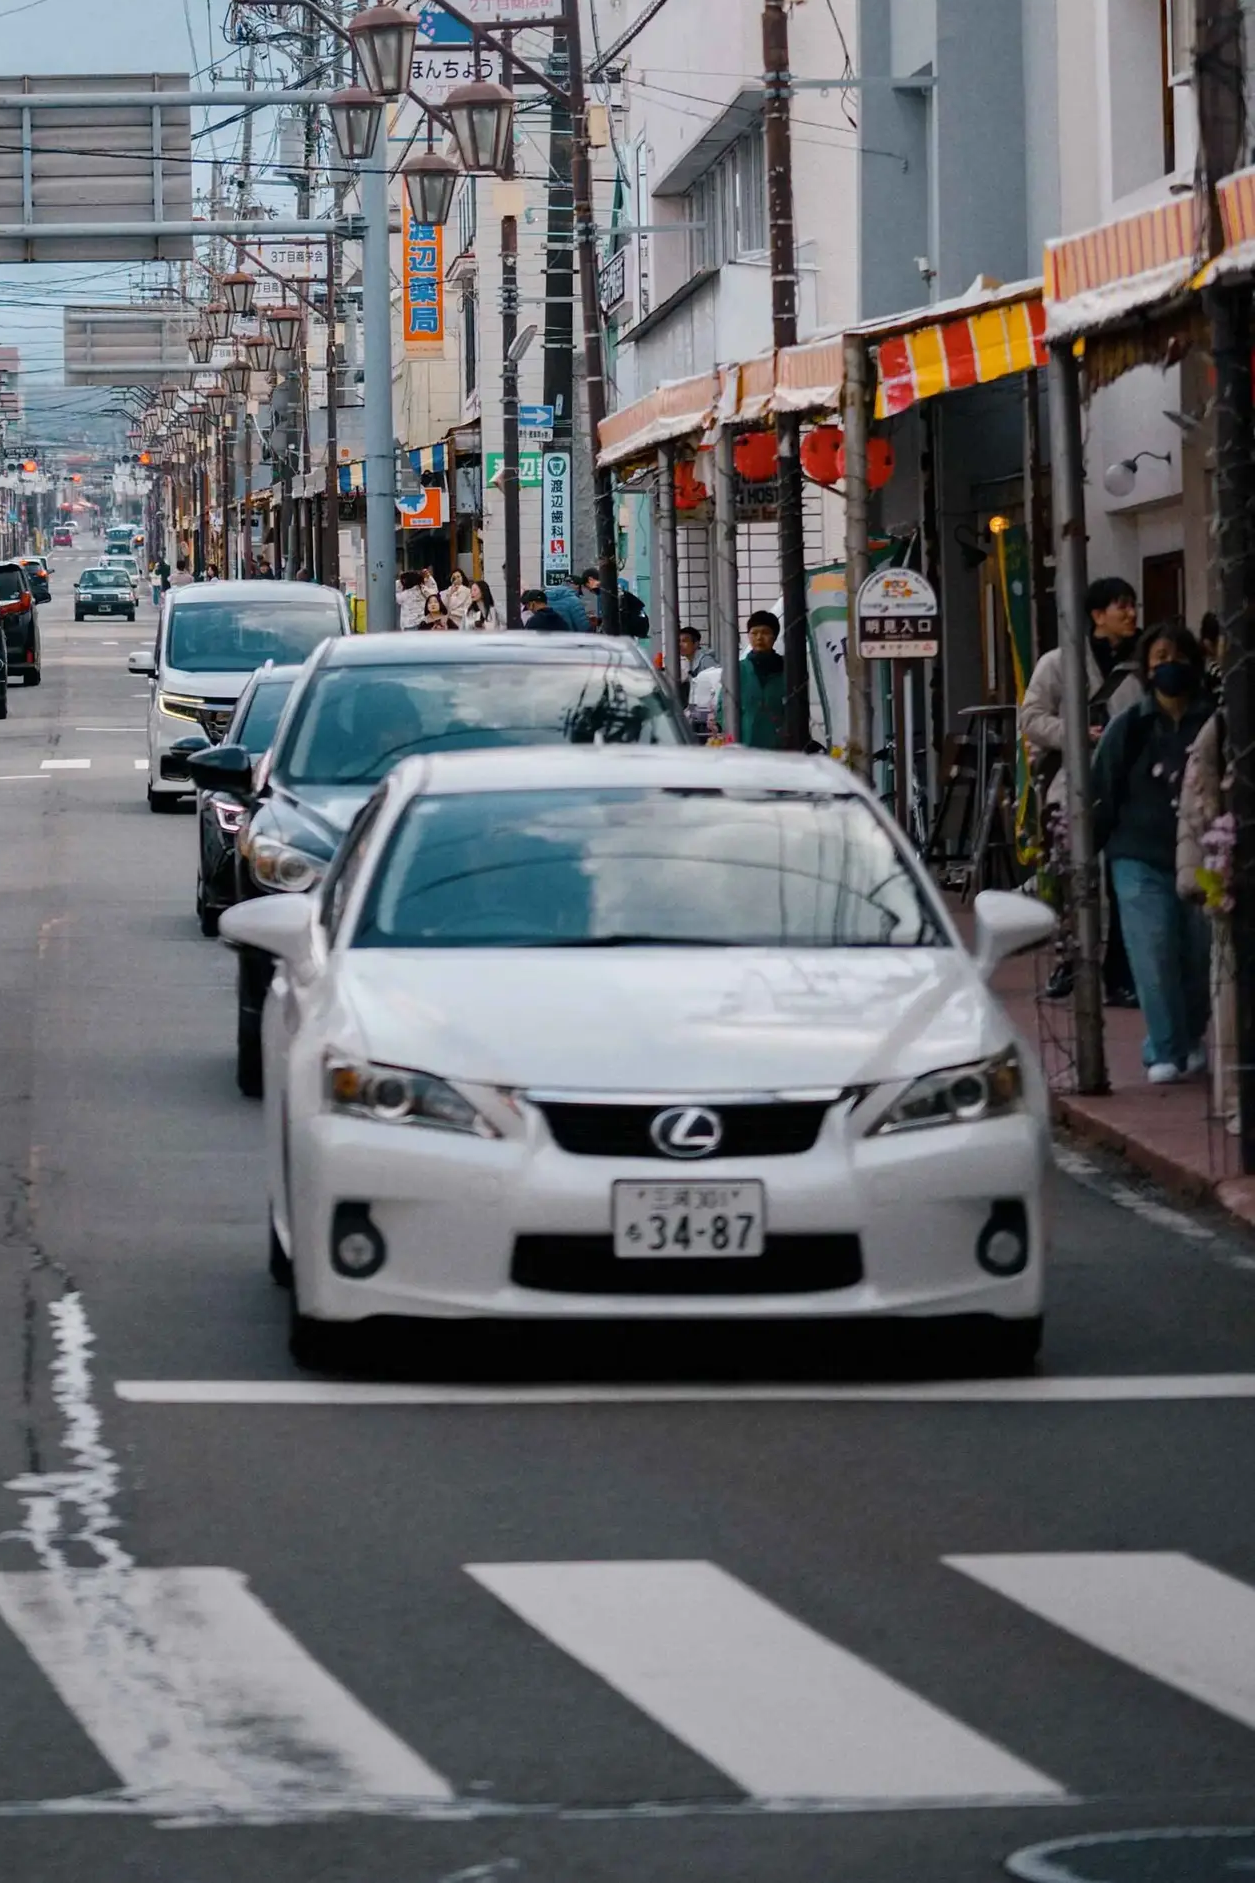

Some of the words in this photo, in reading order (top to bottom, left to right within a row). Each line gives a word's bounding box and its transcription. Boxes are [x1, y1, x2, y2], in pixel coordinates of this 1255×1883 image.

[270, 249, 324, 264] 3丁目商栄会
[550, 479, 565, 538] 渡辺歯科
[865, 619, 932, 634] 明見入口
[647, 1214, 754, 1251] 34-87
